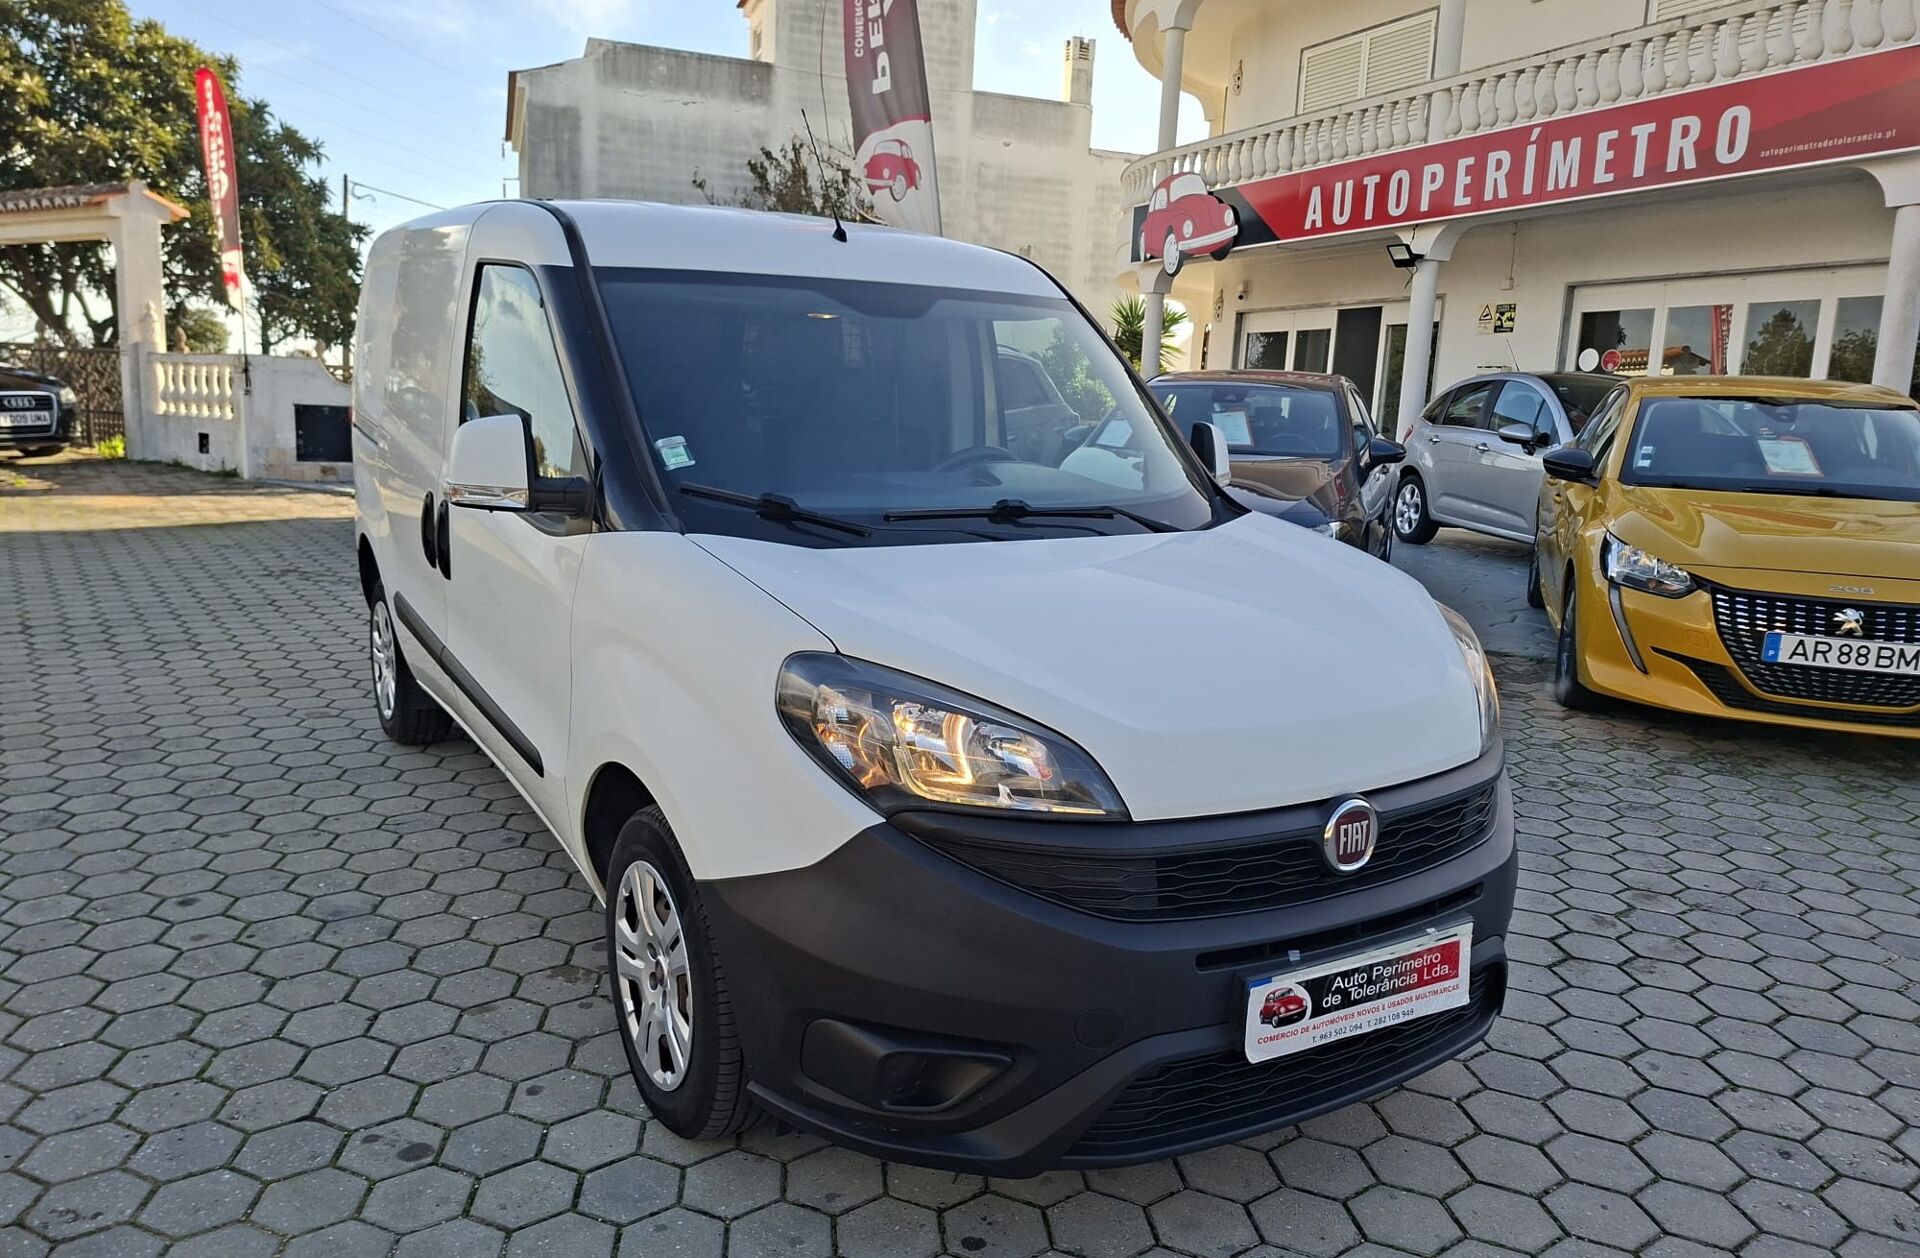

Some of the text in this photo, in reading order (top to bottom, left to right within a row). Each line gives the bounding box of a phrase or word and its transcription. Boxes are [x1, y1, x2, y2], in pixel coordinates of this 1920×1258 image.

[1760, 129, 1897, 158] autoperimetrodetolerancia.pt
[1303, 105, 1752, 230] AUTOPERÍMETRO
[1788, 639, 1920, 671] AR 88 BM
[1339, 820, 1369, 855] FIAT
[1322, 963, 1453, 1008] de Tolerância Lda.
[1332, 952, 1441, 991] Auto Perímetro
[1301, 1025, 1311, 1035] DE
[1357, 1005, 1381, 1018] NOVOS
[1382, 1003, 1387, 1011] E
[1388, 996, 1414, 1009] USADOS
[1415, 983, 1460, 1001] MULTIMARCAS
[1319, 1030, 1333, 1041] 963
[1334, 1025, 1347, 1037] 502
